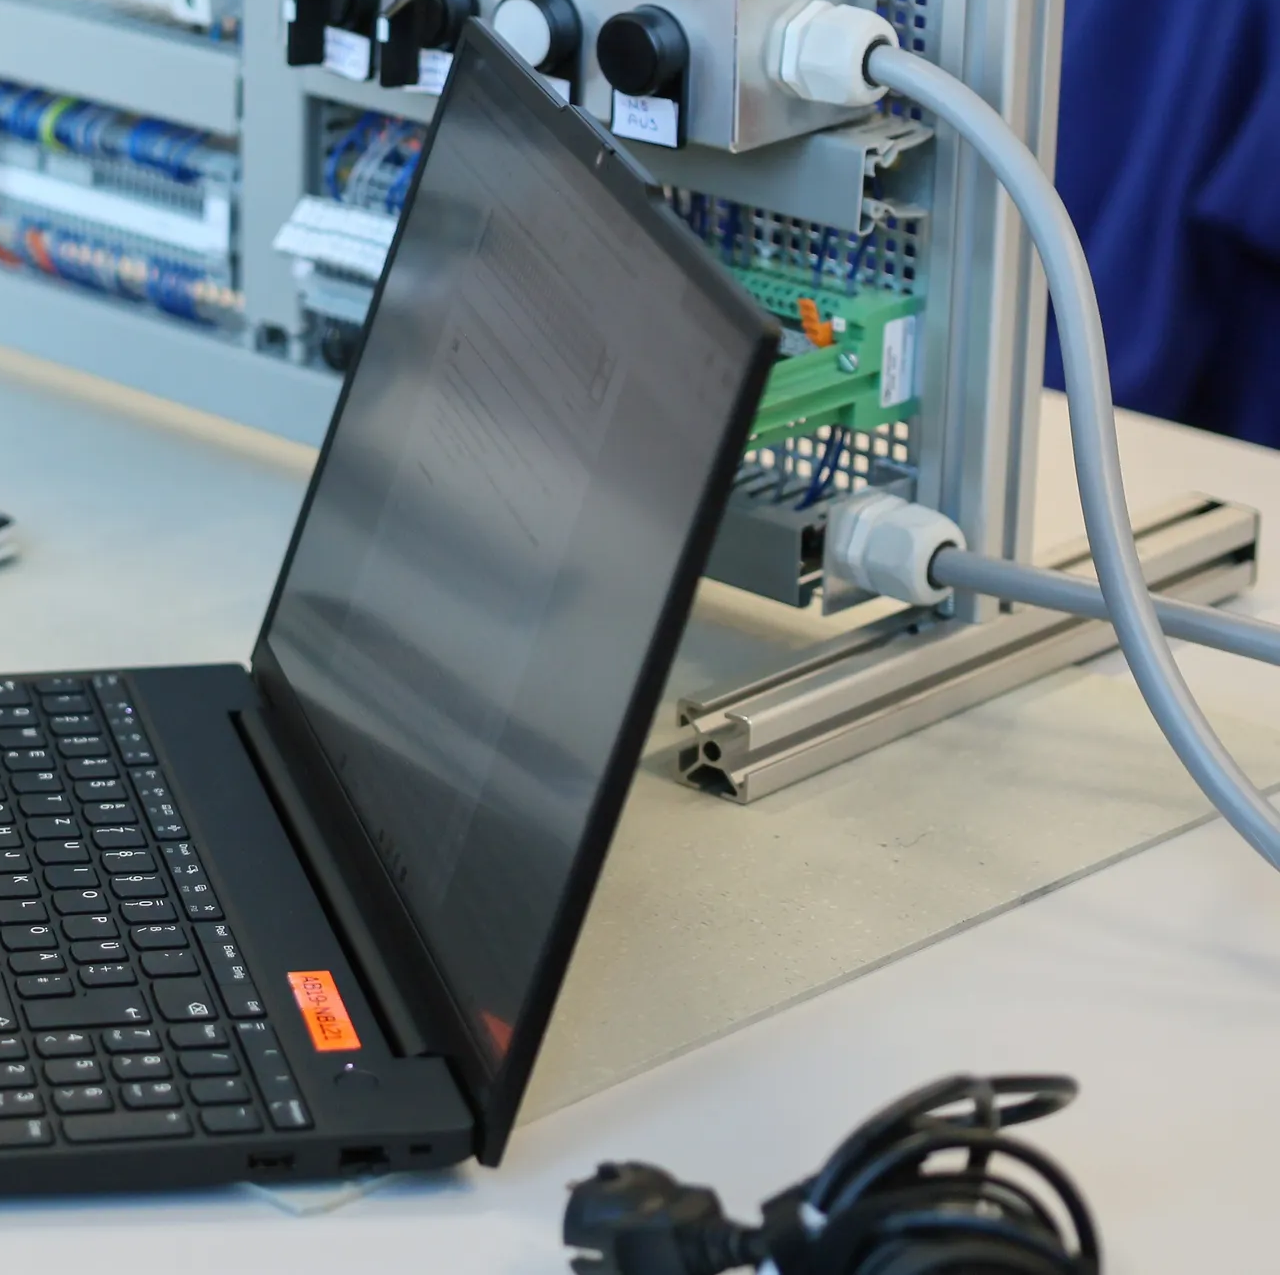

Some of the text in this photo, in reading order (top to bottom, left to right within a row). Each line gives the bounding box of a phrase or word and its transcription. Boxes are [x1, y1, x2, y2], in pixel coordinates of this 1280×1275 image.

[13, 875, 28, 883] K
[82, 890, 98, 898] O
[92, 915, 108, 923] P
[30, 926, 49, 934] Ö
[223, 944, 236, 958] Ende
[67, 1033, 84, 1041] 4
[143, 1055, 161, 1064] 8
[76, 1060, 94, 1068] 5
[7, 1064, 26, 1073] 2
[84, 1087, 103, 1097] 6
[16, 1092, 35, 1102] 3
